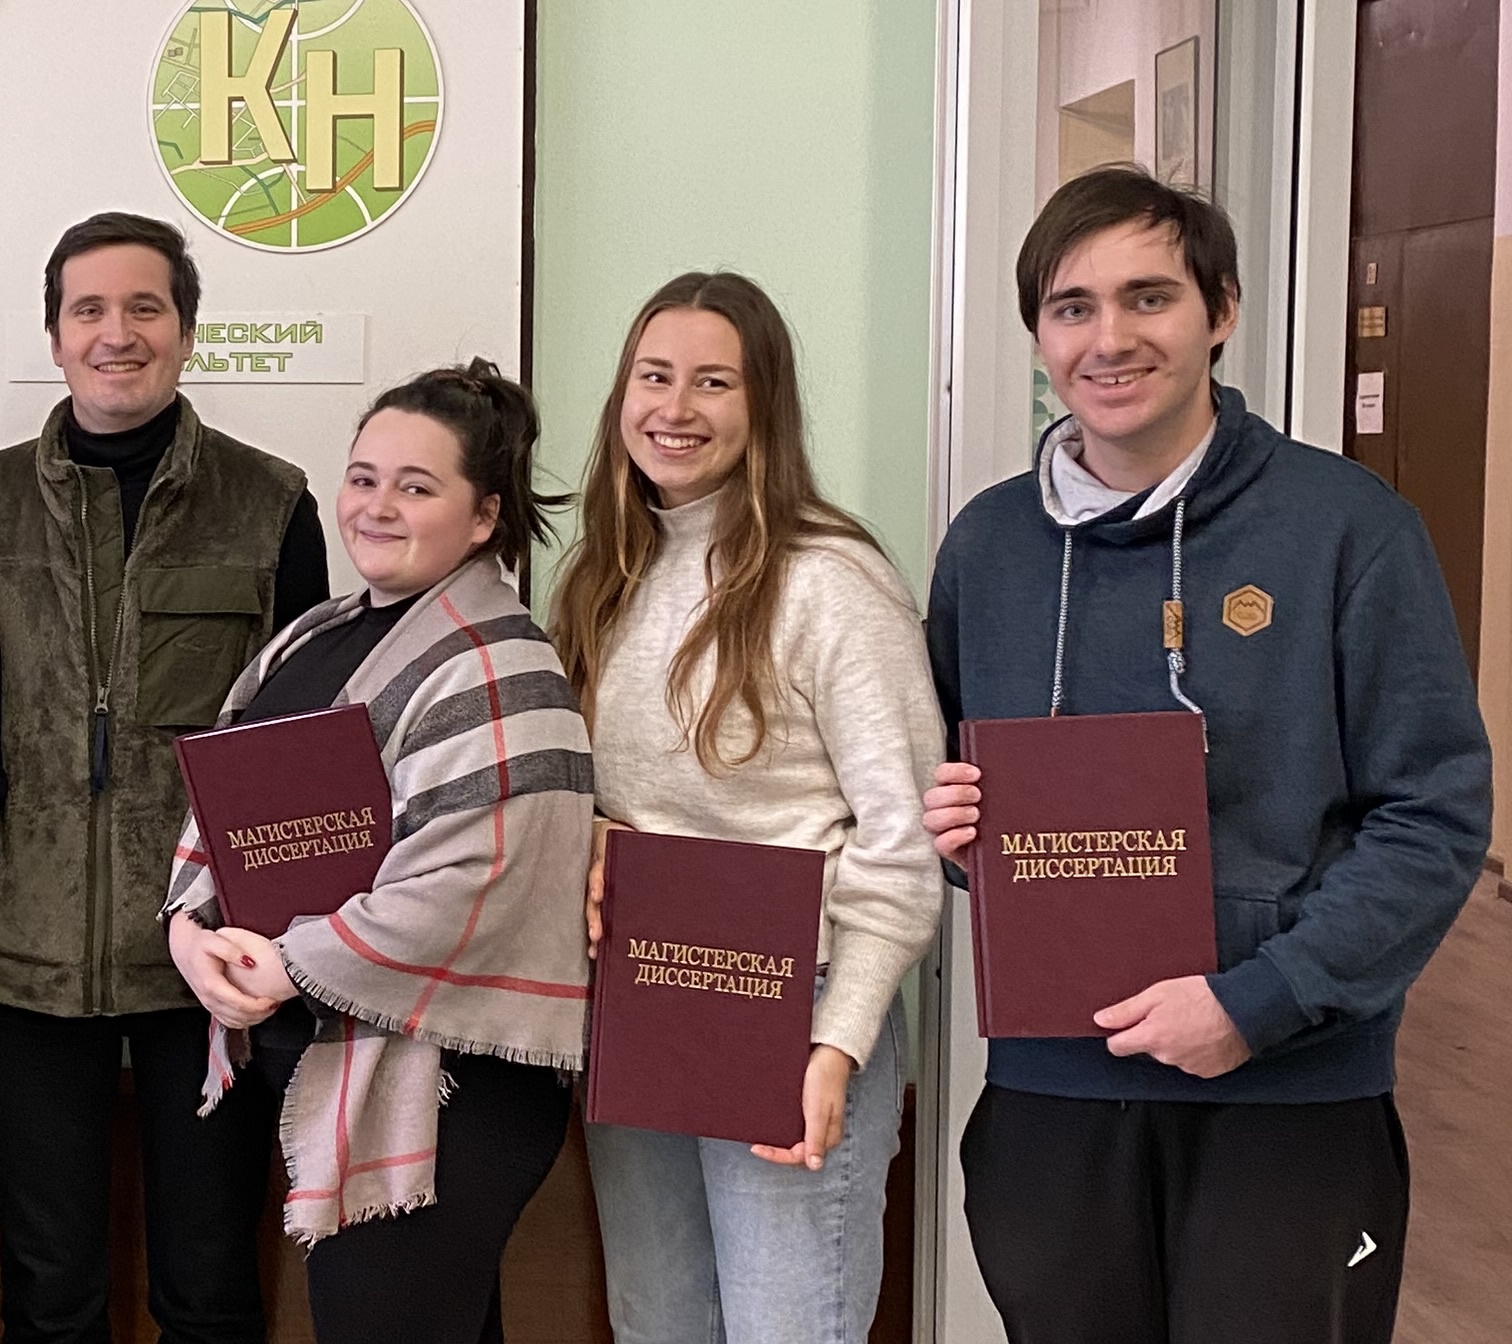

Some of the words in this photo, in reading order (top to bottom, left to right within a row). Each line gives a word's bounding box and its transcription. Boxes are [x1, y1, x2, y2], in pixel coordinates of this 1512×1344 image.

[199, 7, 405, 193] КН
[226, 806, 376, 849] МАГИСТЕРСКАЯ
[1000, 829, 1187, 855] МАГИСТЕРСКАЯ
[242, 830, 375, 872] ДИССЕРТАЦИЯ
[1012, 856, 1178, 883] ДИССЕРТАЦИЯ
[627, 938, 795, 978] МАГИСТЕРСКАЯ
[634, 964, 784, 999] ДИССЕРТАЦИЯ
